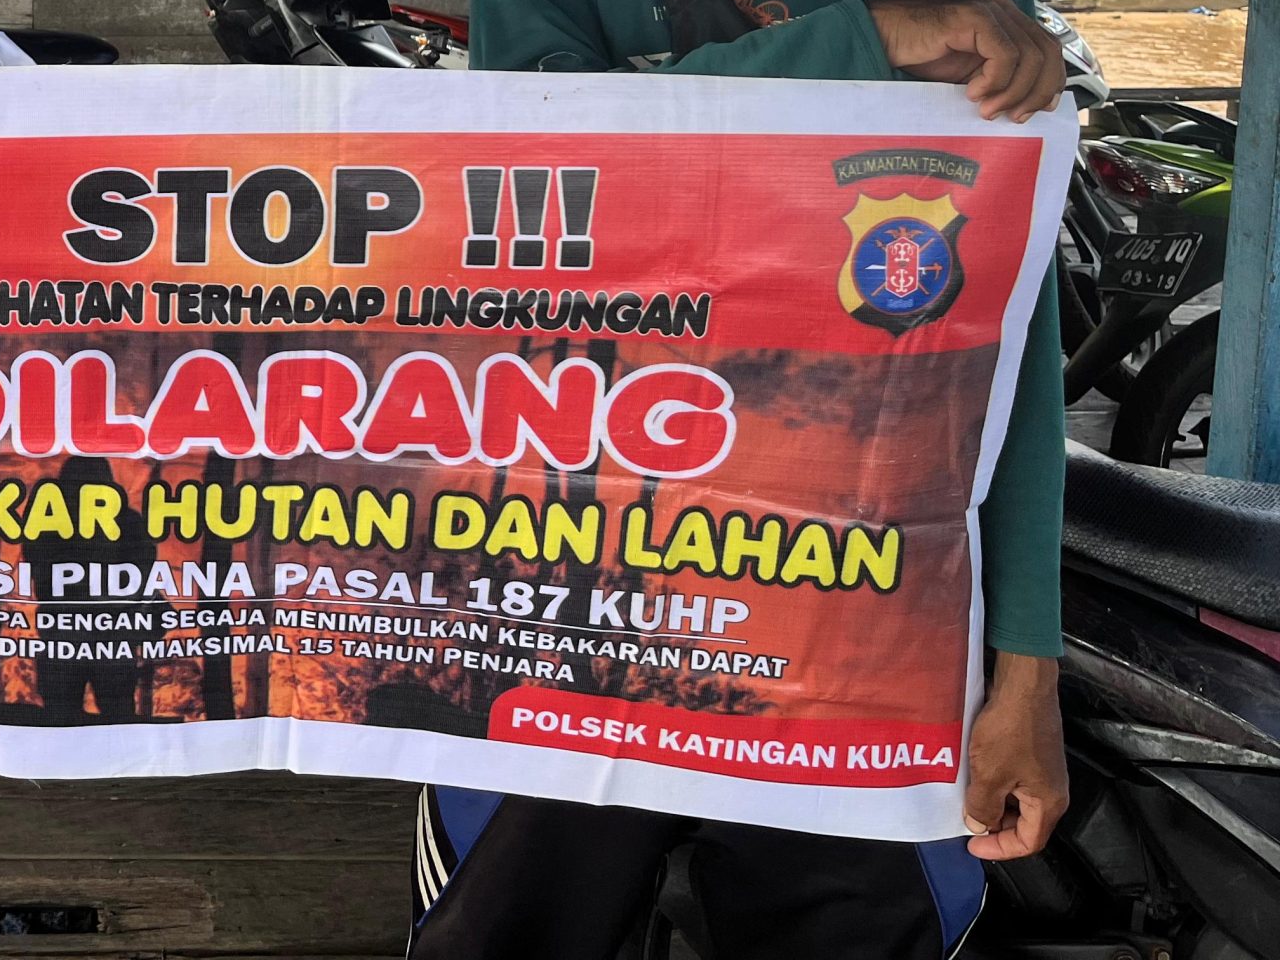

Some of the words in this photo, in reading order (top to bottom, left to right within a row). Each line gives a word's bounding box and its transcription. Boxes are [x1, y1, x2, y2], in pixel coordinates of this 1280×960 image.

[838, 156, 919, 180] KALIMANTAN
[923, 157, 974, 180] TENGAH
[63, 166, 423, 268] STOP
[461, 166, 599, 270] !!!
[152, 282, 386, 327] TERHADAP
[395, 286, 711, 338] LINGKUNGAN
[144, 481, 412, 551] HUTAN
[431, 493, 602, 566] DAN
[622, 504, 902, 592] LAHAN
[51, 560, 256, 598] PIDANA
[273, 562, 447, 606] PASAL
[466, 577, 570, 621] 187
[588, 588, 751, 633] KUHP
[36, 612, 152, 632] DENGAN
[160, 608, 266, 629] SEGAJA
[274, 608, 488, 642] MENIMBULKAN
[498, 628, 681, 670] KEBAKARAN
[690, 650, 789, 678] DAPAT
[142, 633, 290, 659] MAKSIMAL
[299, 638, 333, 654] 15
[341, 638, 434, 664] TAHUN
[443, 647, 575, 683] PENJARA
[512, 707, 647, 746] POLSEK
[659, 728, 836, 769] KATINGAN
[846, 742, 954, 770] KUALA
